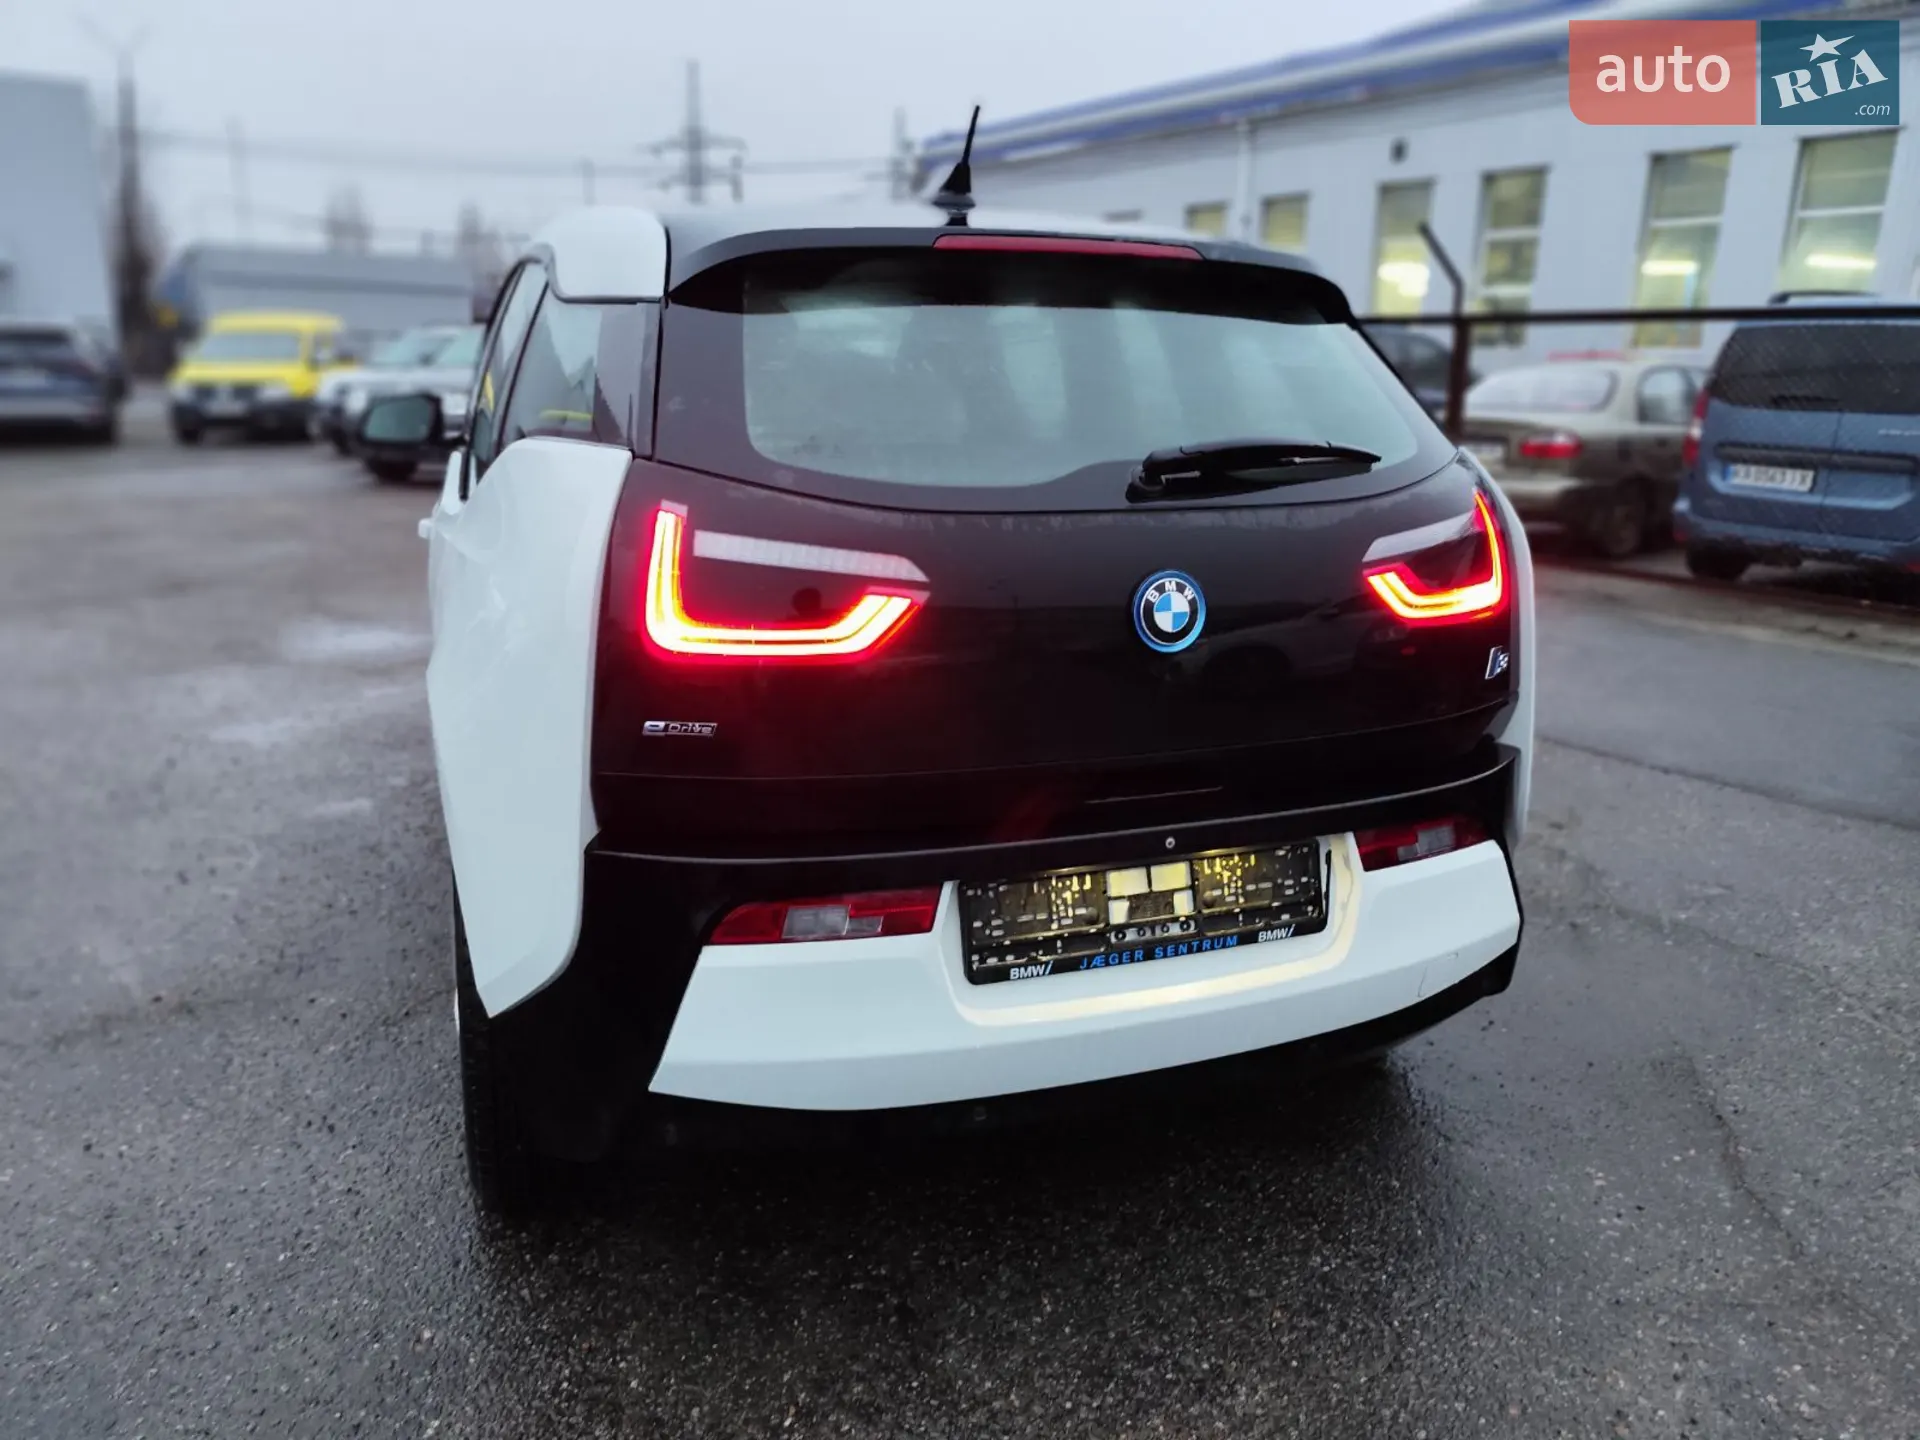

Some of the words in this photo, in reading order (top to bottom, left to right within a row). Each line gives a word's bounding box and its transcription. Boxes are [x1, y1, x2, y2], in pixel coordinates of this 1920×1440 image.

[1147, 581, 1195, 603] BMW
[1079, 950, 1144, 970] JÆGER
[1154, 935, 1238, 959] SENTRUM
